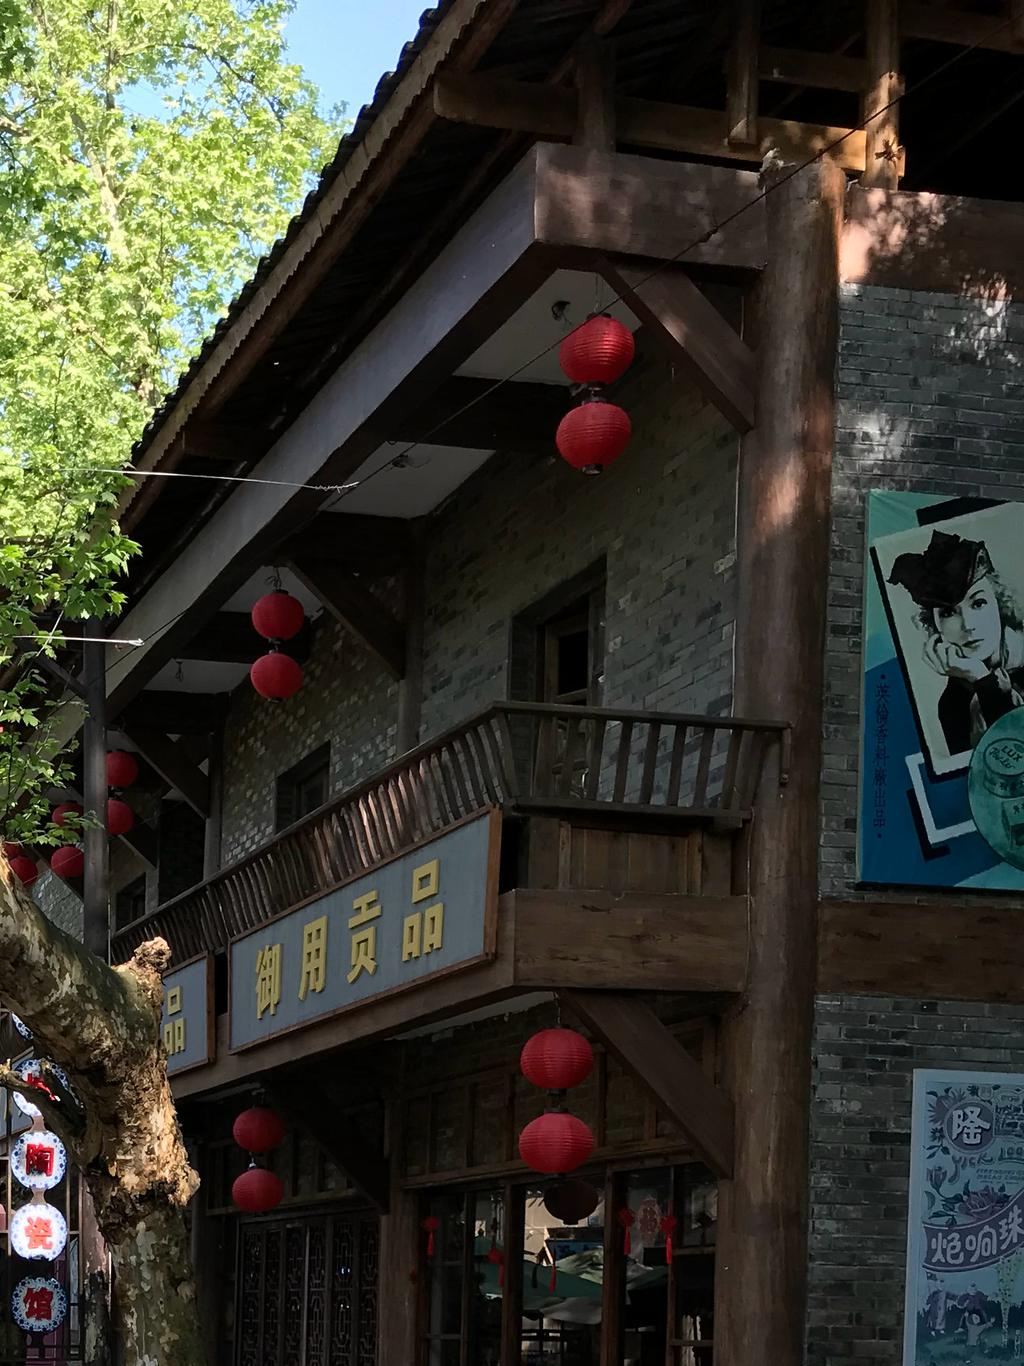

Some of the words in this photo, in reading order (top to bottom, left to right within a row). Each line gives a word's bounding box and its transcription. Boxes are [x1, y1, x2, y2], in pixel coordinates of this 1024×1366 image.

[1001, 745, 1023, 763] LUX
[255, 858, 444, 1020] 御用贡品
[163, 984, 185, 1056] 品
[952, 1105, 992, 1146] 隆
[23, 1073, 58, 1321] 陶瓷馆
